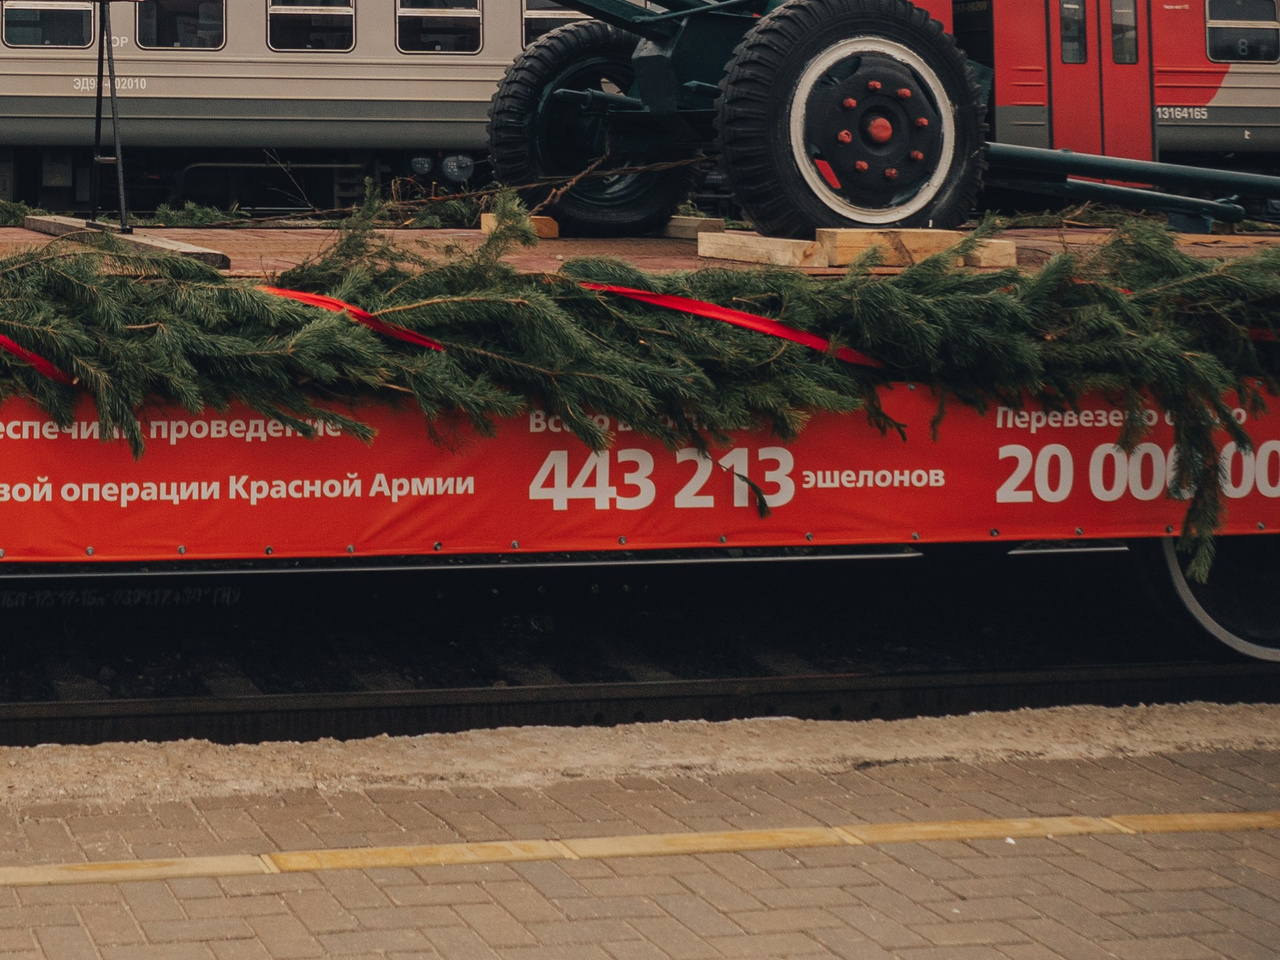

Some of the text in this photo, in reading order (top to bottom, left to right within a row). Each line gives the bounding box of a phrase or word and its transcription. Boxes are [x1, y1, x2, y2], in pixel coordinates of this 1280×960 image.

[73, 78, 147, 91] ЭД9-02010
[1156, 107, 1208, 119] 13164165
[529, 409, 610, 433] Всо
[996, 406, 1158, 434] Перевезео
[529, 446, 946, 511] 443 213 эшелонов
[996, 444, 1074, 503] 20
[60, 480, 220, 507] операции
[228, 473, 363, 505] Красной
[369, 473, 475, 502] Армии
